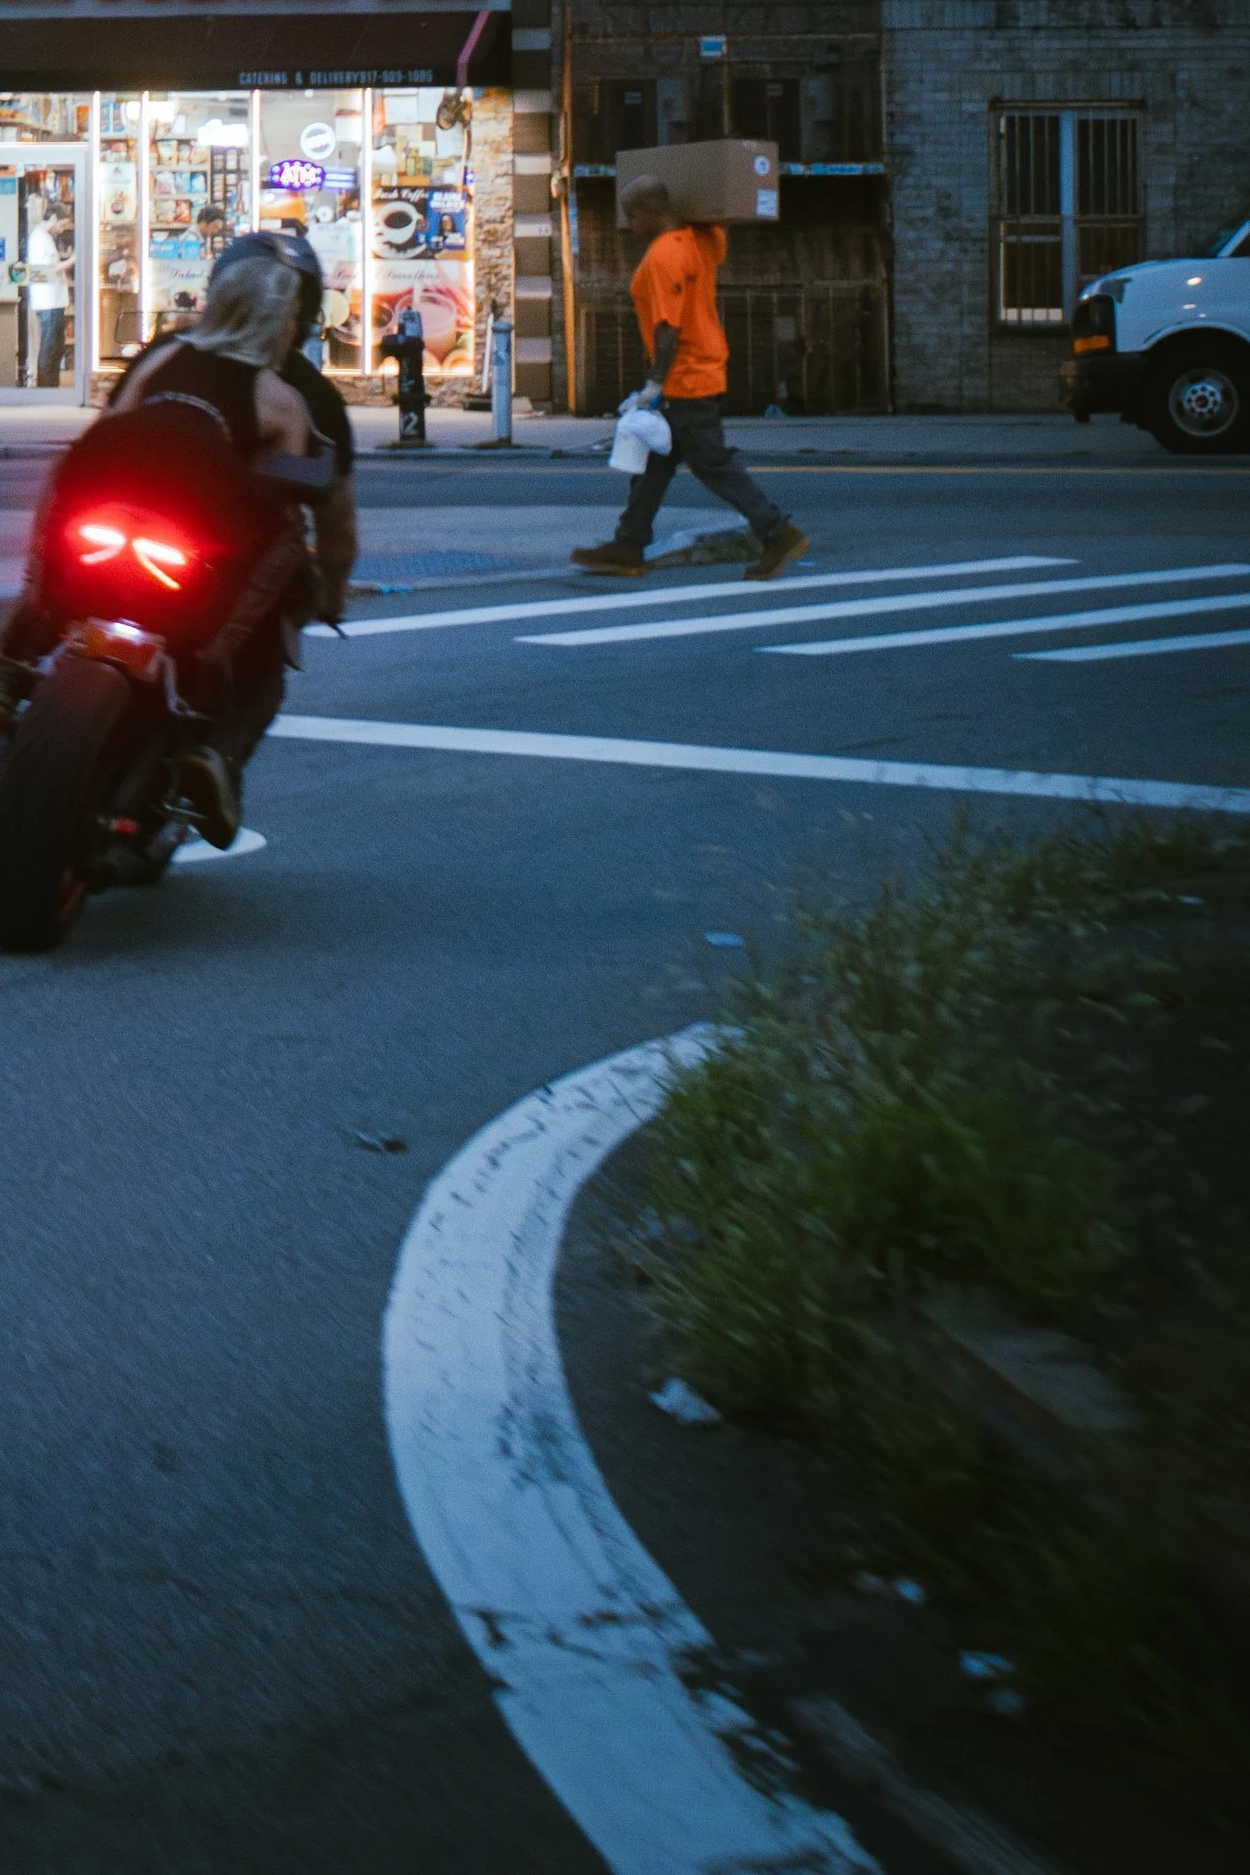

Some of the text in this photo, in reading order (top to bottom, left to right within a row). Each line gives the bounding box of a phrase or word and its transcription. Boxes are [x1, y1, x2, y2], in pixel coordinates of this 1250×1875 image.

[239, 71, 288, 85] CATERING
[309, 70, 358, 84] DELIVERY
[280, 165, 317, 184] ATM
